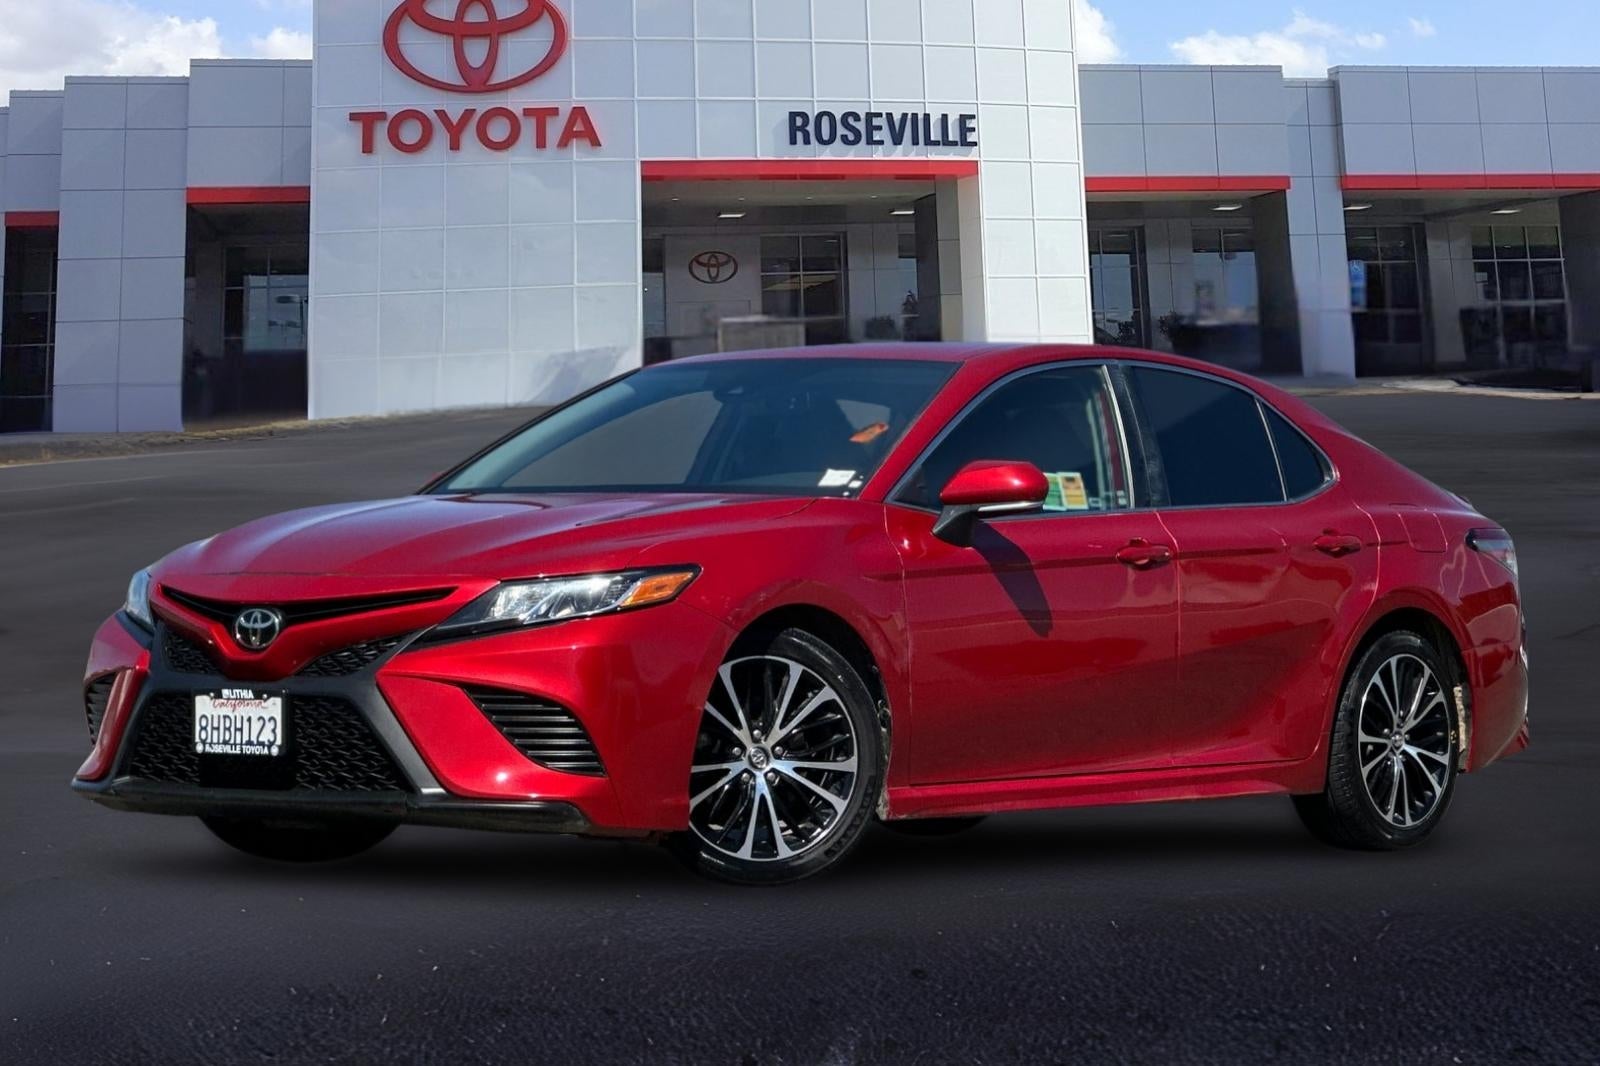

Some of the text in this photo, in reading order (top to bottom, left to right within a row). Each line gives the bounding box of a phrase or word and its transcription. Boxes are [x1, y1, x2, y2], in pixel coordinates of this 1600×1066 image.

[349, 106, 602, 154] TOYOTA
[788, 111, 978, 147] ROSEVILLE
[213, 700, 268, 712] California
[199, 714, 277, 745] 8HBH123
[242, 745, 269, 754] TOYOTA
